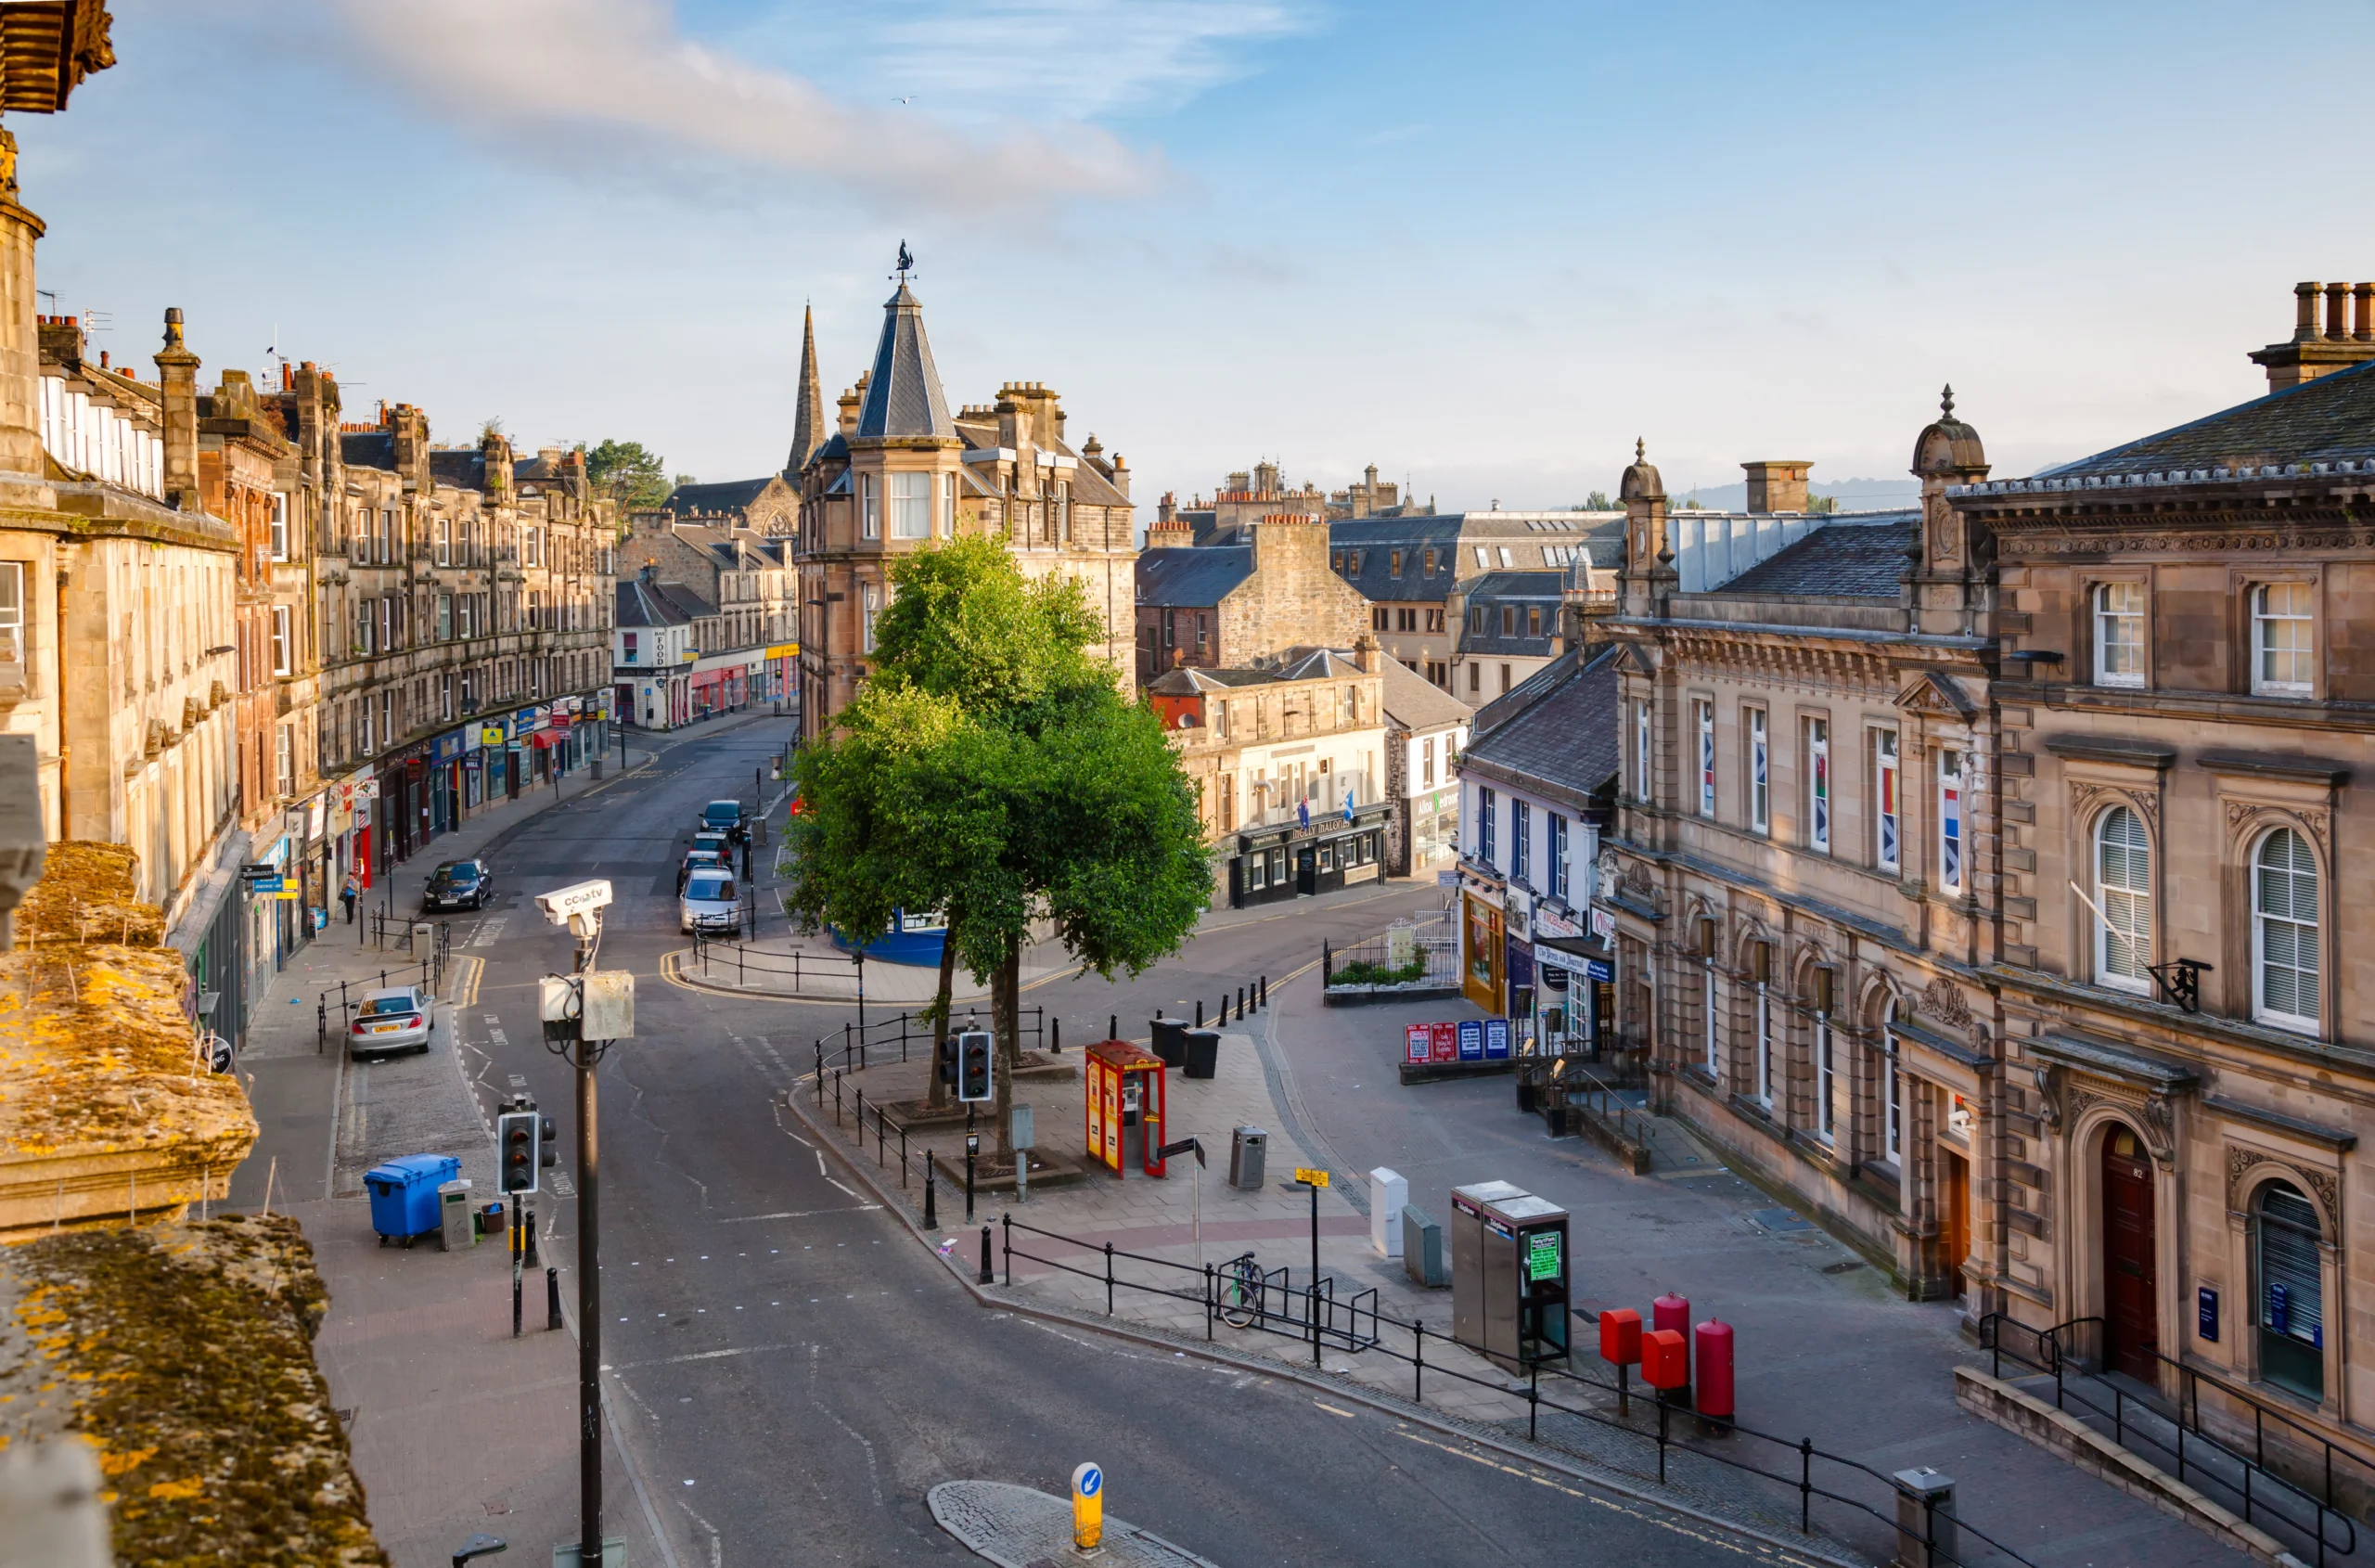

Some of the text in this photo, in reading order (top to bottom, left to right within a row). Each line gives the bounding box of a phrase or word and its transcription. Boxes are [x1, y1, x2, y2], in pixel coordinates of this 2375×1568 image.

[1418, 800, 1432, 816] Alloa
[1292, 824, 1316, 839] MOLLY
[1252, 836, 1265, 845] Original
[1746, 900, 1765, 914] POST
[1804, 921, 1828, 940] OFFICE
[1546, 948, 1558, 960] Press
[1566, 955, 1584, 968] Journal
[2133, 1168, 2143, 1178] 82
[1457, 1202, 1475, 1216] Telephone
[1490, 1218, 1508, 1233] Telephone
